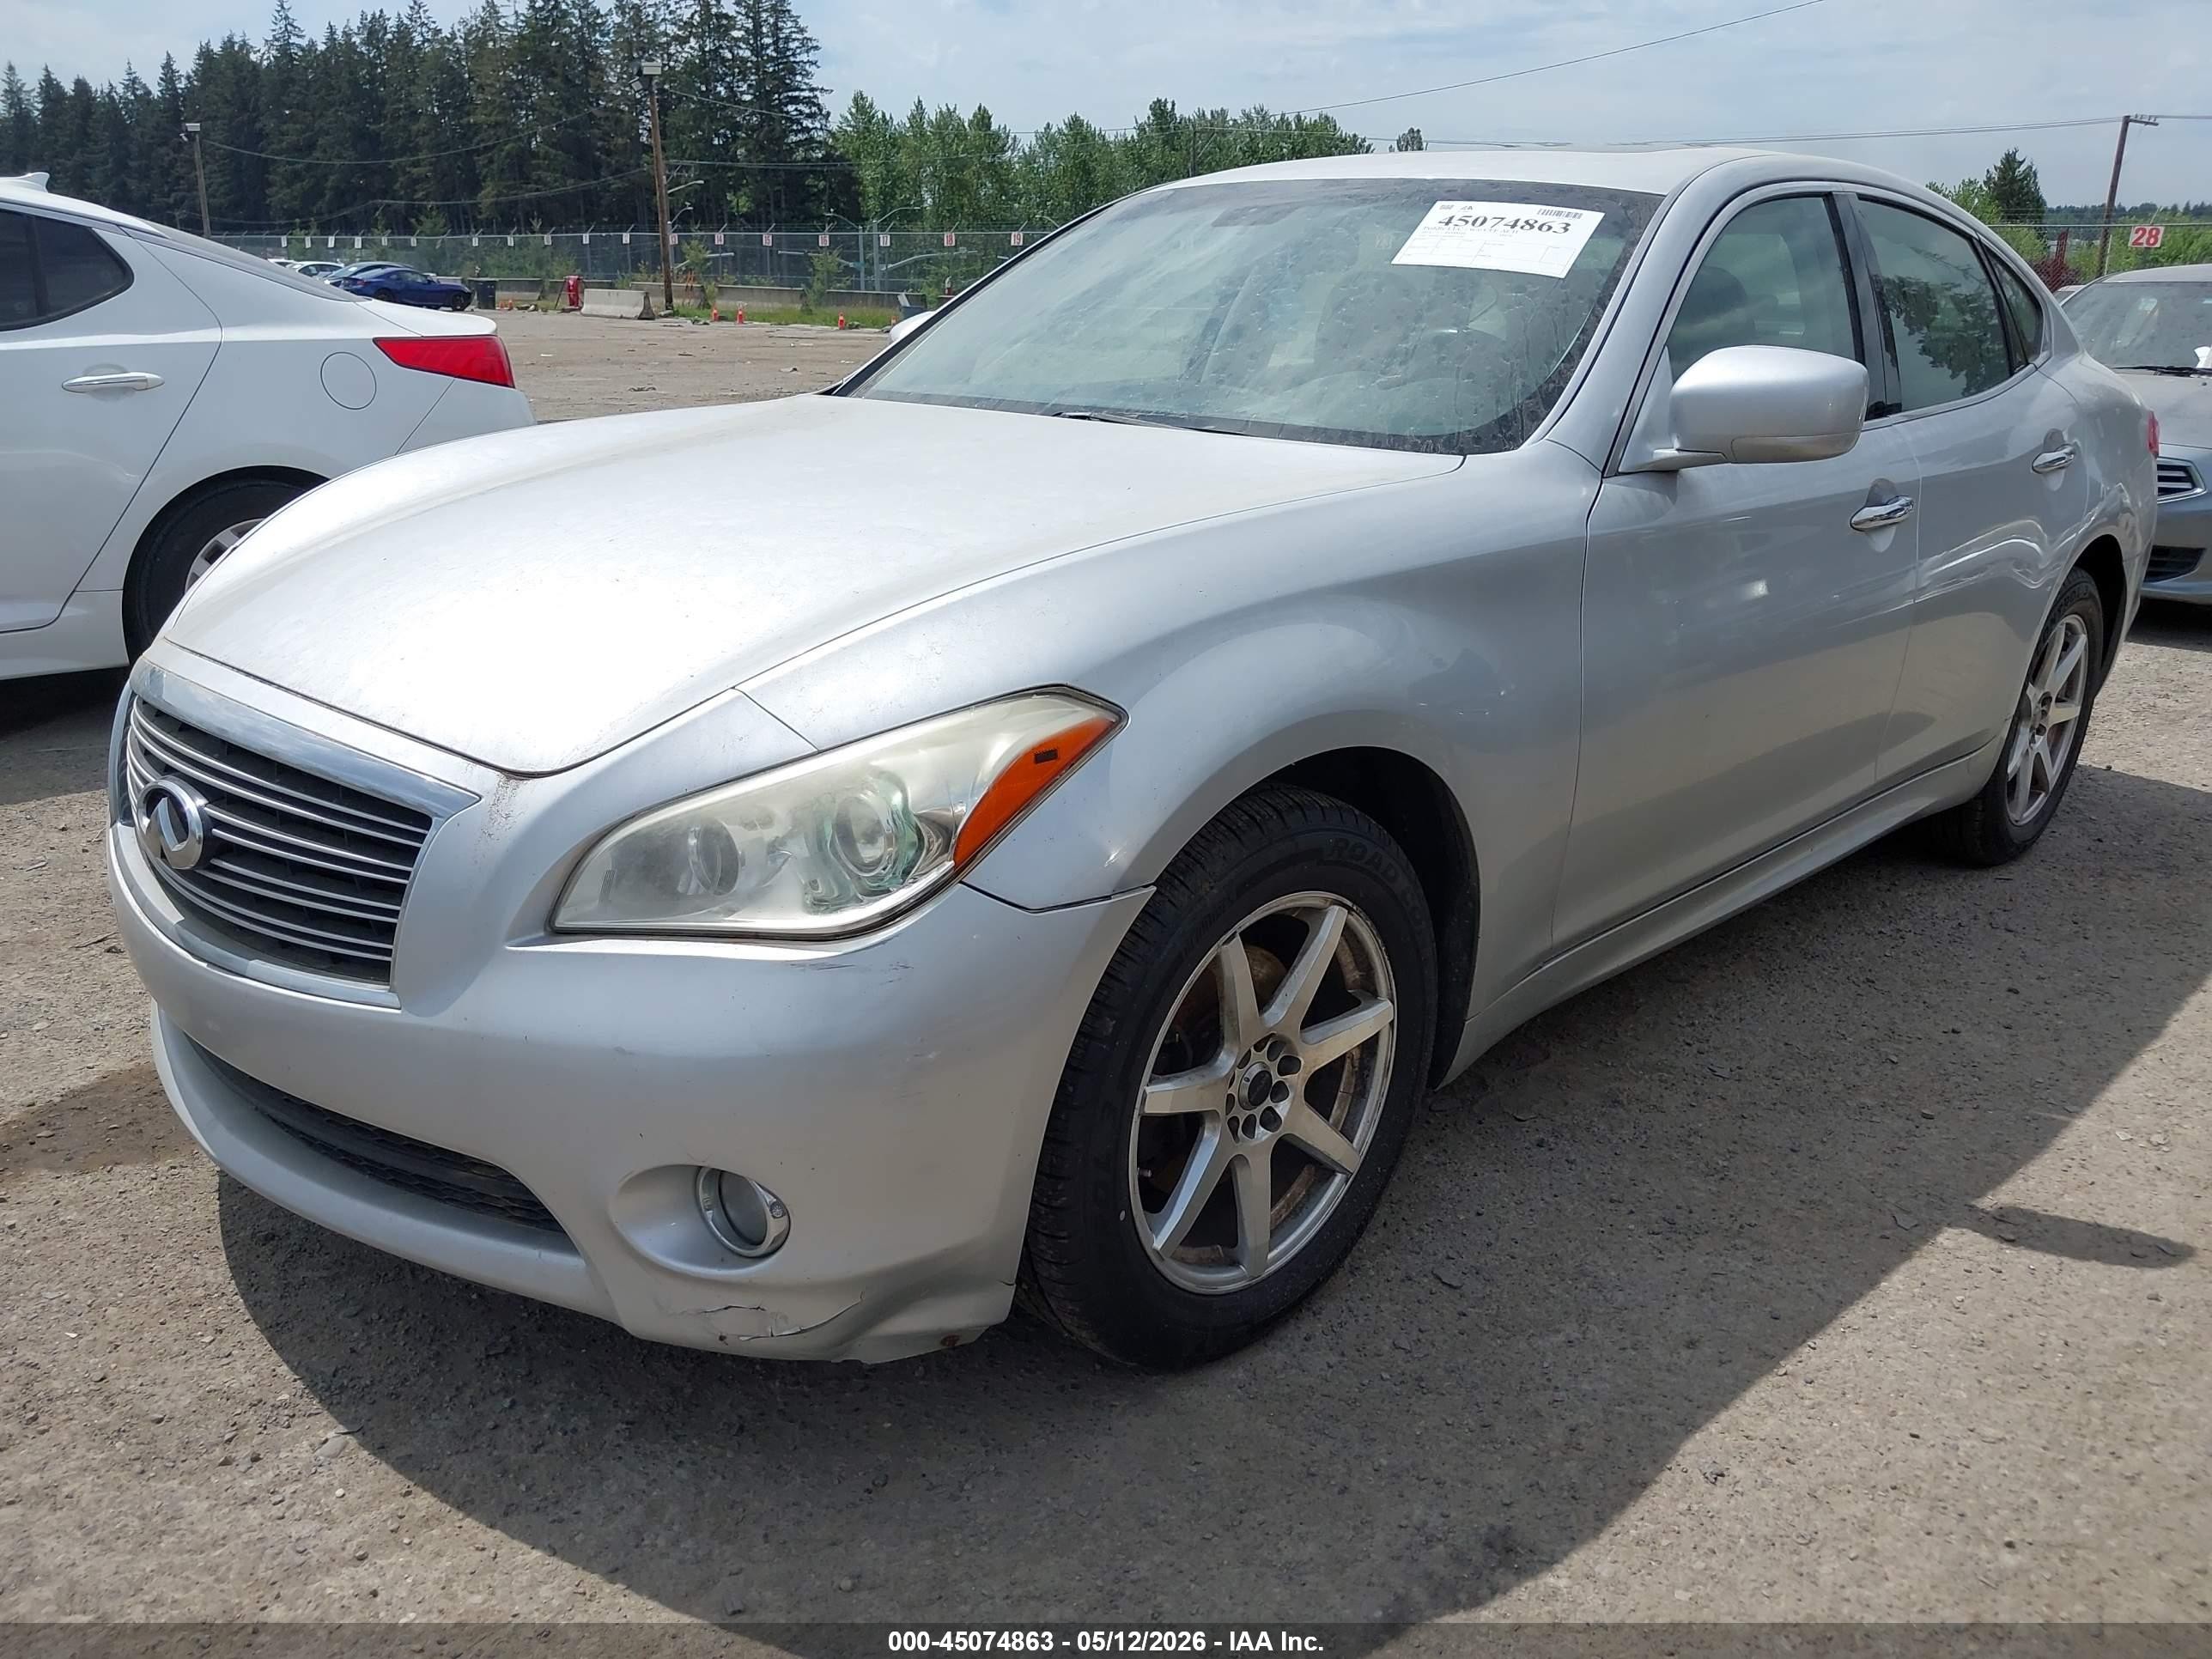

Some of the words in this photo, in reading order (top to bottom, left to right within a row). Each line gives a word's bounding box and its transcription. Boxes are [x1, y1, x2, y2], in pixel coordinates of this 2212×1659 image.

[1437, 215, 1571, 234] 45074863
[945, 233, 954, 246] 18
[1013, 233, 1022, 246] 19
[2131, 227, 2161, 247] 28
